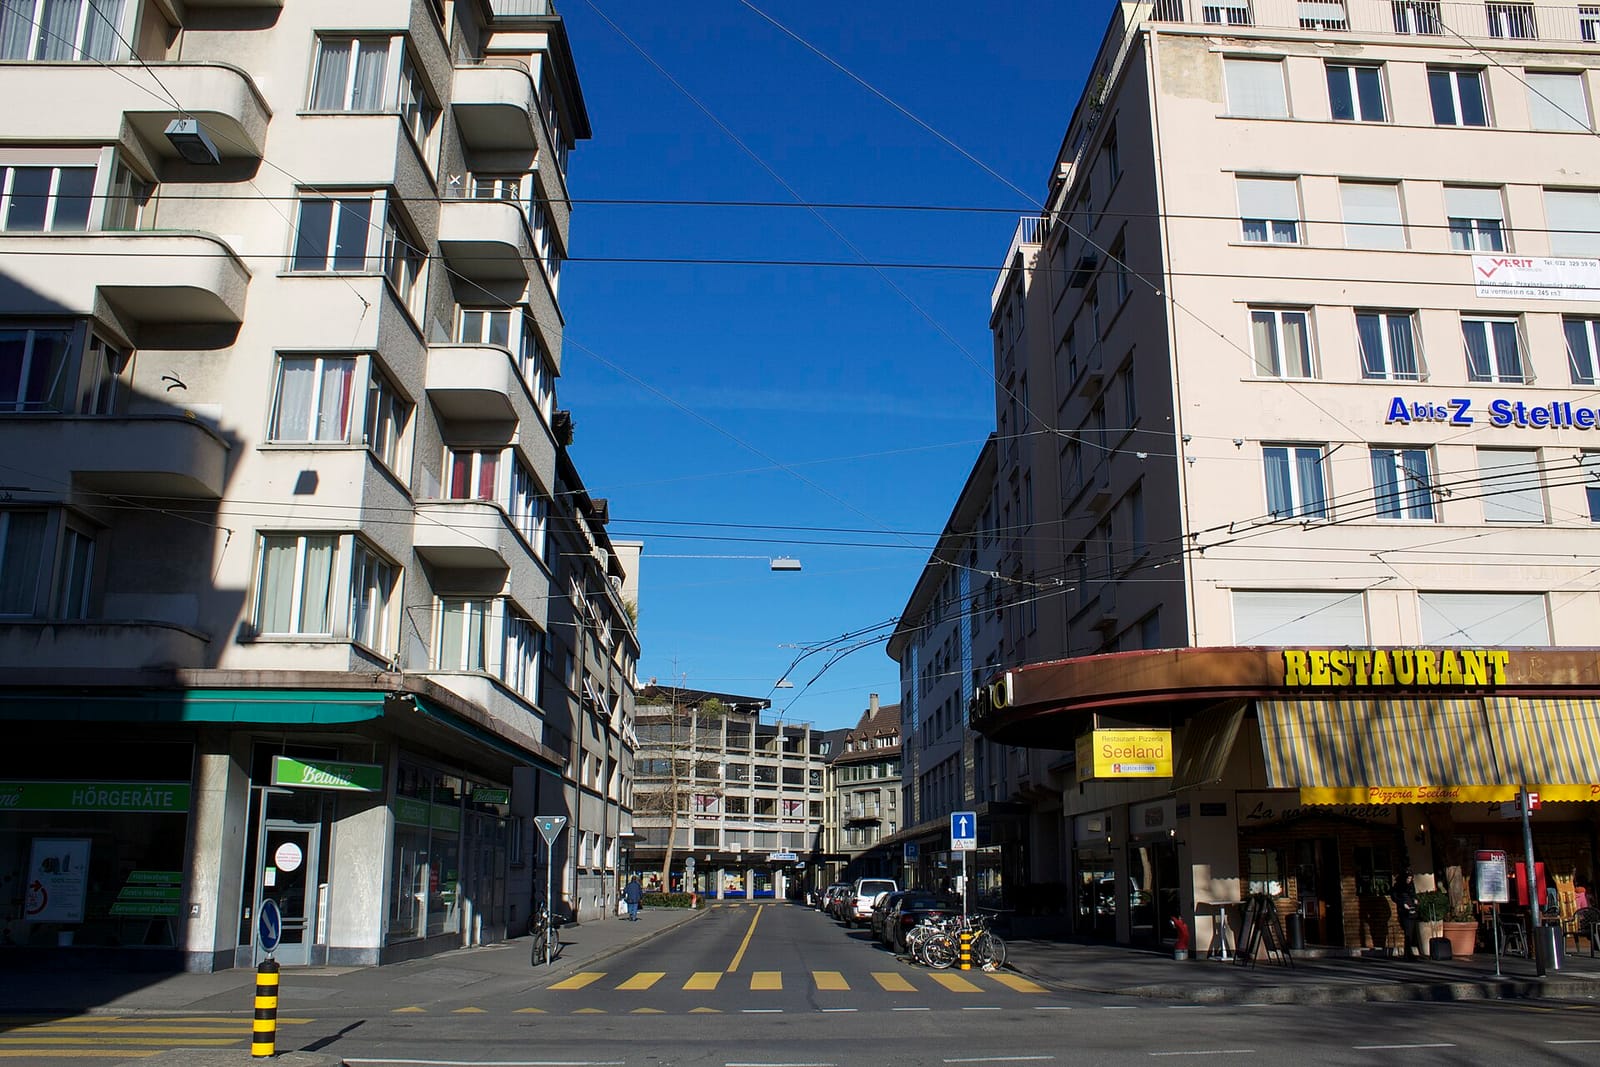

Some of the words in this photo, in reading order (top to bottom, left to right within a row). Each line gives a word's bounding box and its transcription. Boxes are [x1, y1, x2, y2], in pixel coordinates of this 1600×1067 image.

[1283, 649, 1510, 687] RESTAURANT
[1102, 744, 1164, 759] Seeland
[72, 787, 174, 807] HÖRGERÄTE
[1369, 786, 1413, 803] Pizzeria
[1417, 786, 1461, 800] Seeland
[1527, 793, 1539, 809] F
